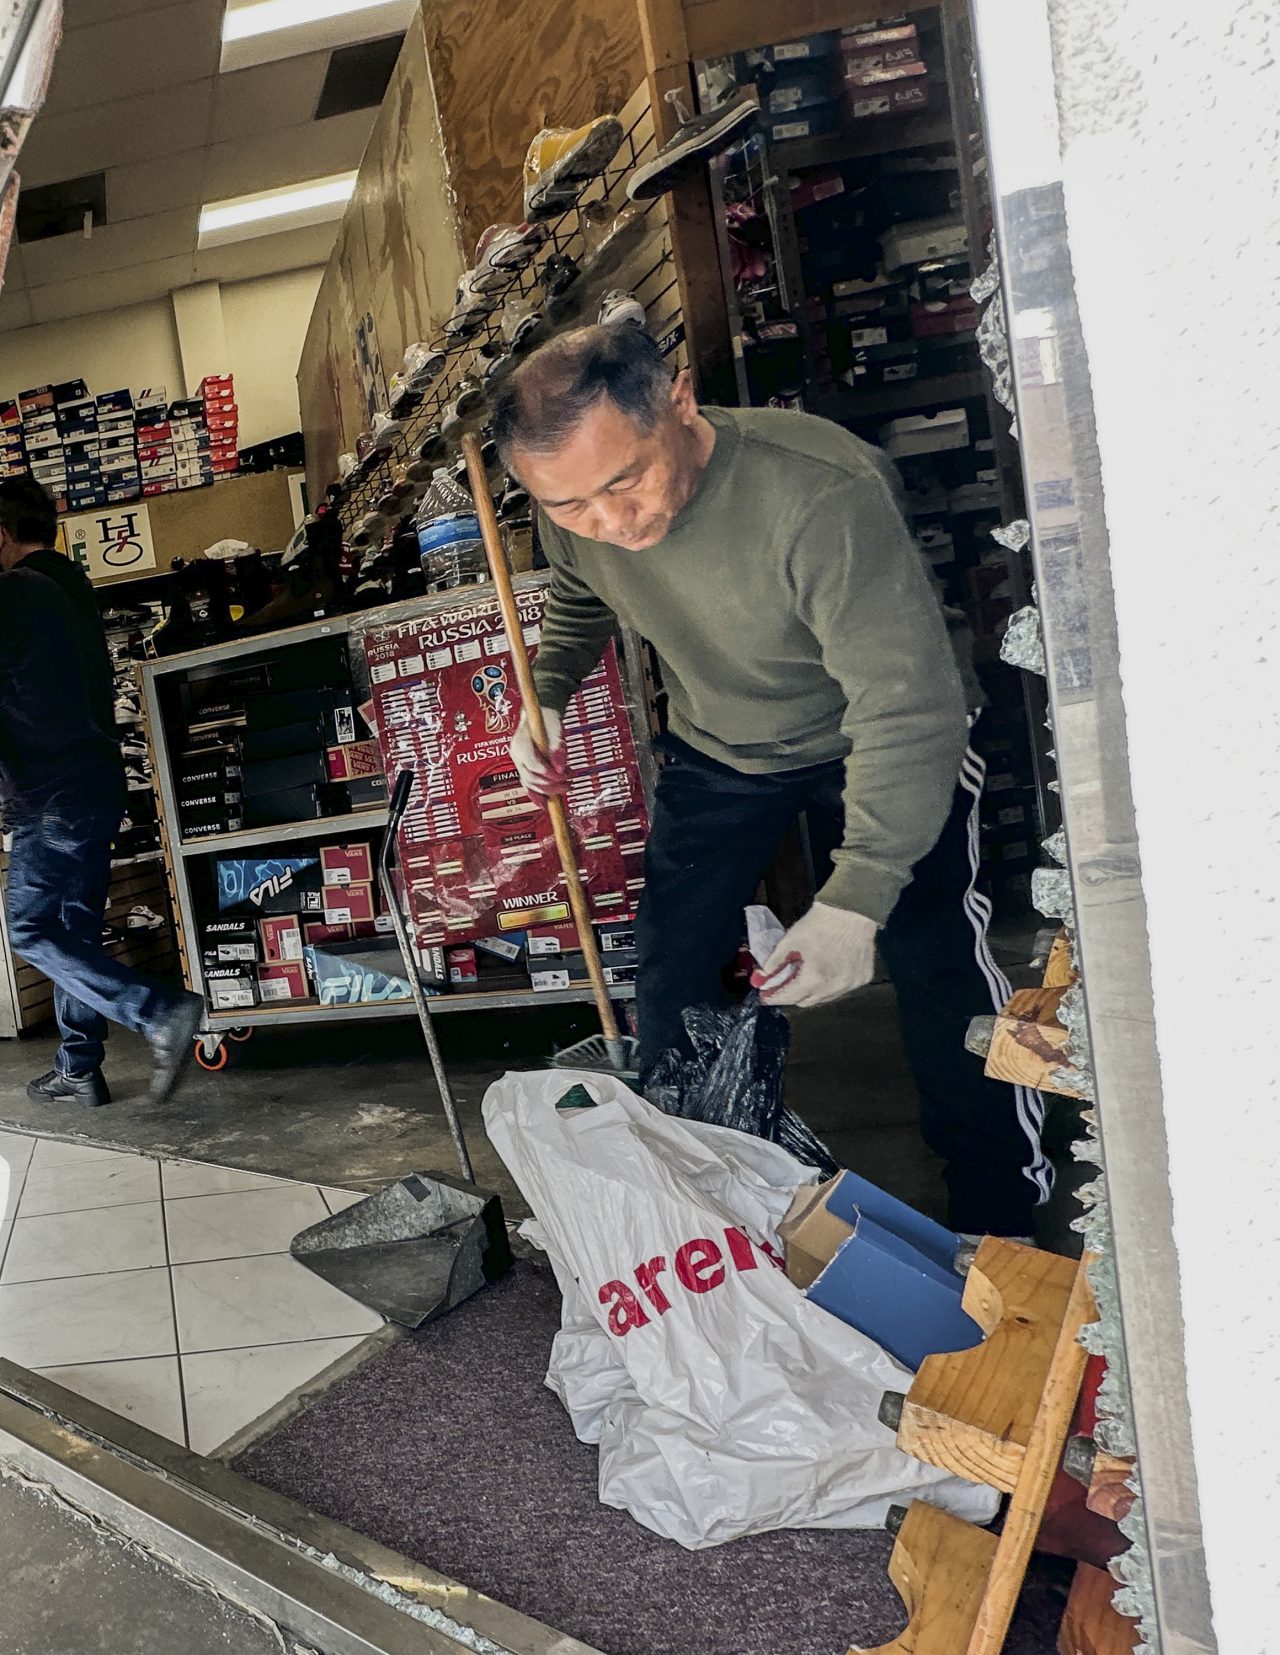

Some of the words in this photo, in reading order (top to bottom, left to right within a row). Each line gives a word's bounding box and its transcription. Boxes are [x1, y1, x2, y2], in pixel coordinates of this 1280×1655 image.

[398, 617, 438, 638] FIFA
[440, 601, 501, 627] WORL
[418, 619, 494, 650] RUSSIA
[495, 605, 542, 631] 218
[367, 643, 400, 658] RUSSIA
[375, 650, 395, 661] 2018
[198, 704, 230, 715] CONVERSE
[456, 744, 511, 764] RUSSIA
[182, 772, 217, 783] CONVERSE
[493, 771, 520, 782] FINAL
[181, 797, 216, 807] CONVERSE
[184, 823, 221, 834] CONVERSE
[344, 850, 363, 858] VANS
[249, 865, 293, 906] FILA
[346, 889, 365, 897] VANS
[502, 891, 558, 909] WINNER
[205, 922, 245, 932] SANDALS
[265, 925, 274, 941] VANS
[204, 968, 240, 978] SANDALS
[281, 966, 298, 974] VANS
[320, 973, 413, 1006] FILA
